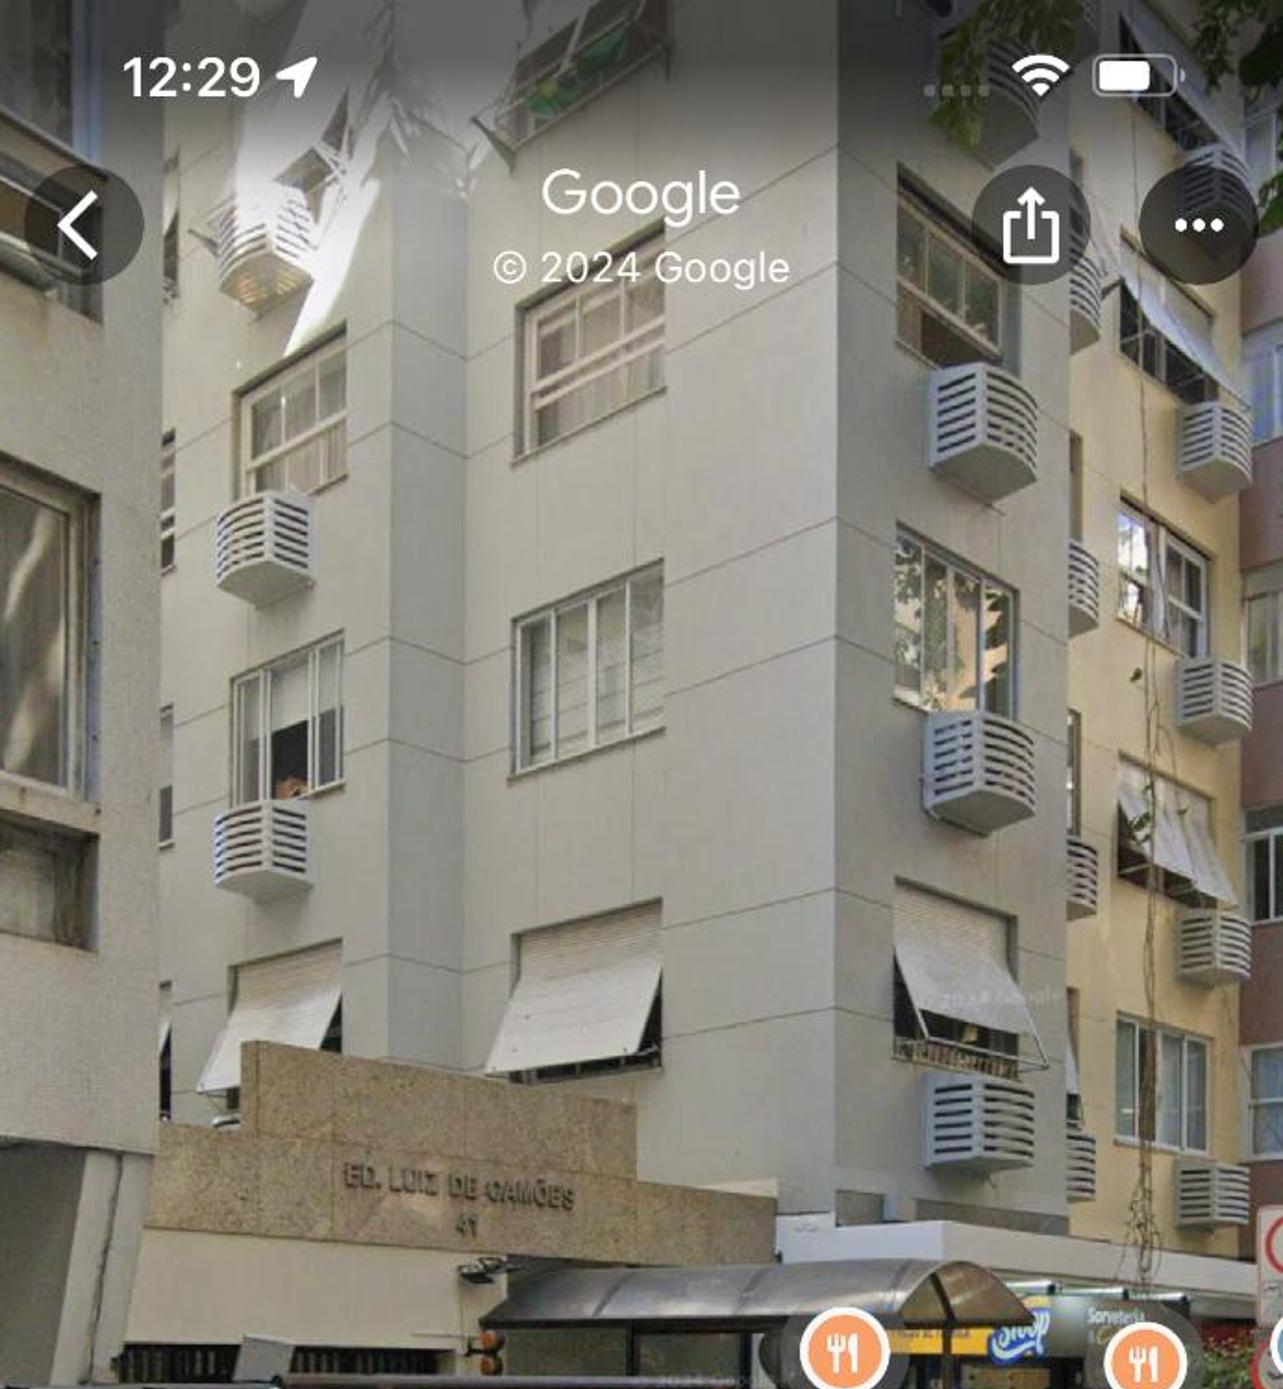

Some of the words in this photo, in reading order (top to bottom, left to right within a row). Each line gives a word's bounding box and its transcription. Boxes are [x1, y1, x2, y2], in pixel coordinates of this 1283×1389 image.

[343, 1161, 381, 1190] ED.
[388, 1167, 440, 1197] LUIZ
[447, 1172, 479, 1200] DE
[485, 1178, 577, 1212] CAMÕES
[456, 1213, 479, 1238] 41
